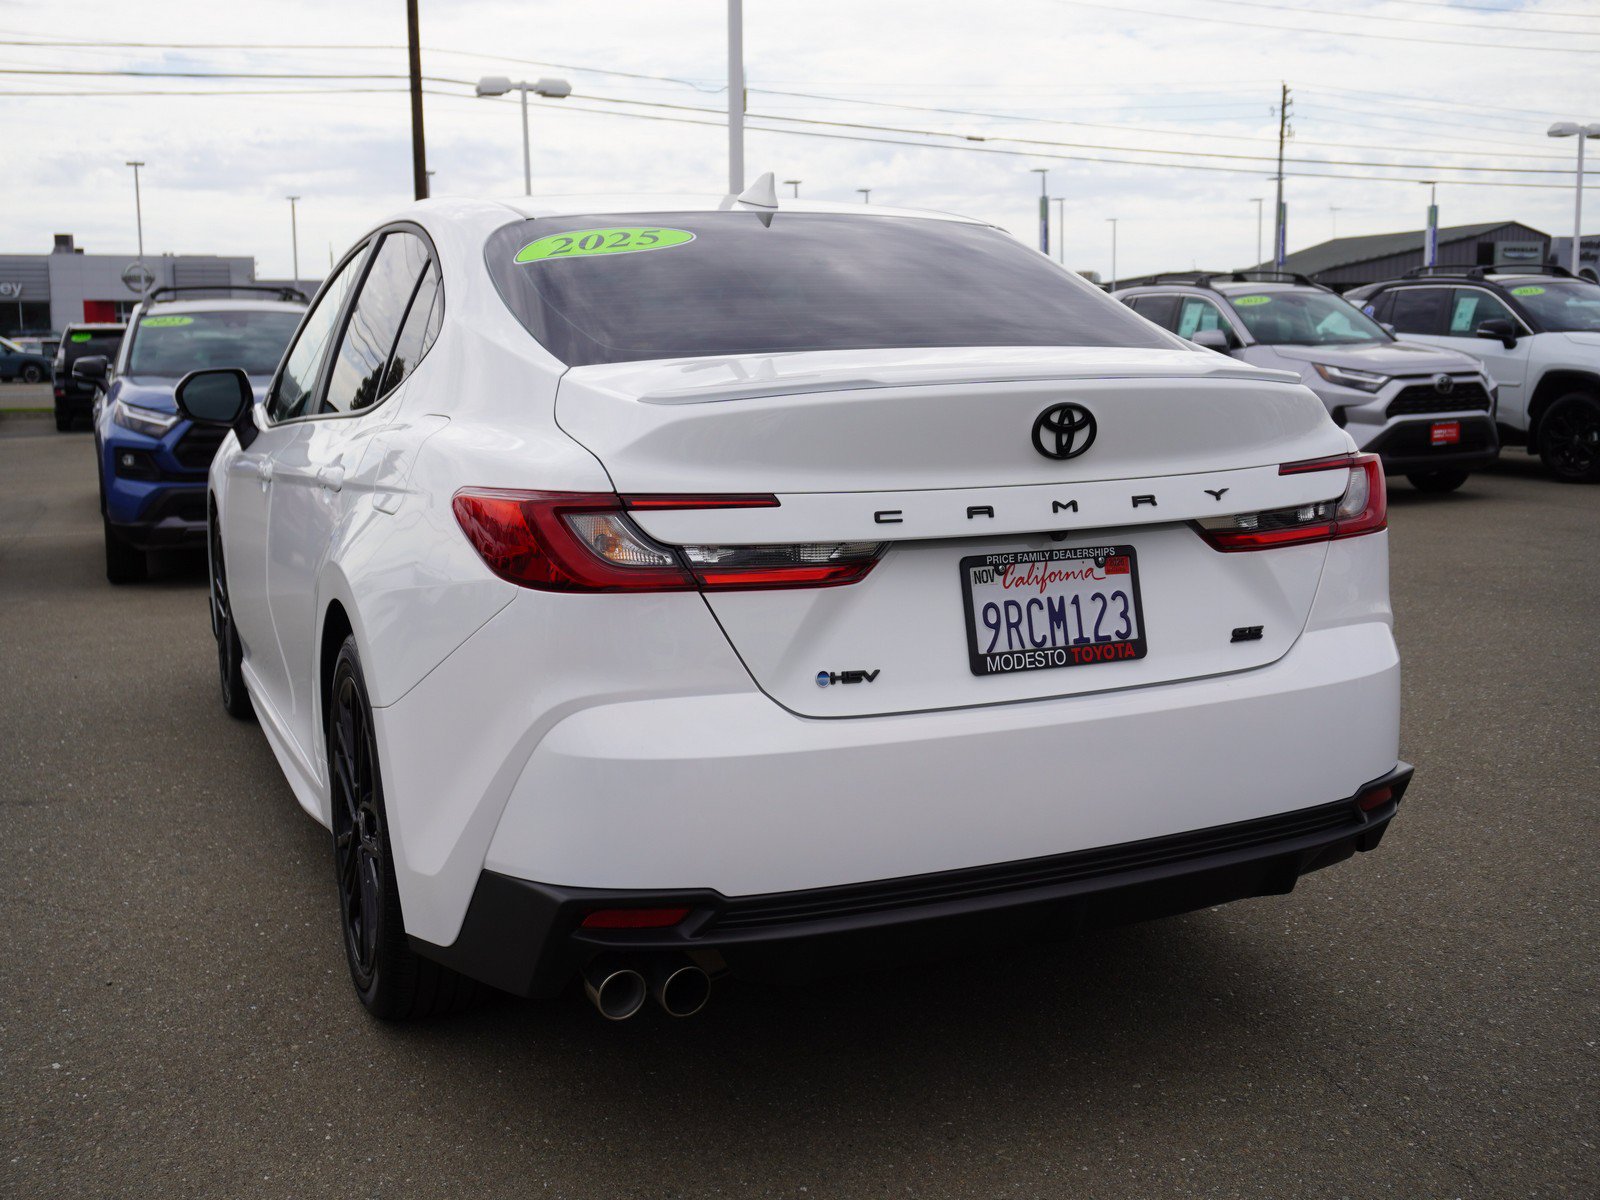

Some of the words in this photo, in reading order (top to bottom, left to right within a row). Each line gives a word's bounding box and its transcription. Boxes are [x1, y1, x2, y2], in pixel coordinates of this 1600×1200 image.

[547, 230, 660, 256] 2025
[986, 555, 1015, 564] PRICE
[1018, 551, 1050, 562] FAMILY
[1053, 547, 1116, 560] DEALERSHIPS
[974, 568, 995, 585] NOV
[1002, 562, 1107, 594] California
[982, 590, 1132, 653] 9RCM123
[986, 649, 1067, 672] MODESTO
[1071, 643, 1136, 663] TOYOTA
[830, 669, 881, 685] HEV
